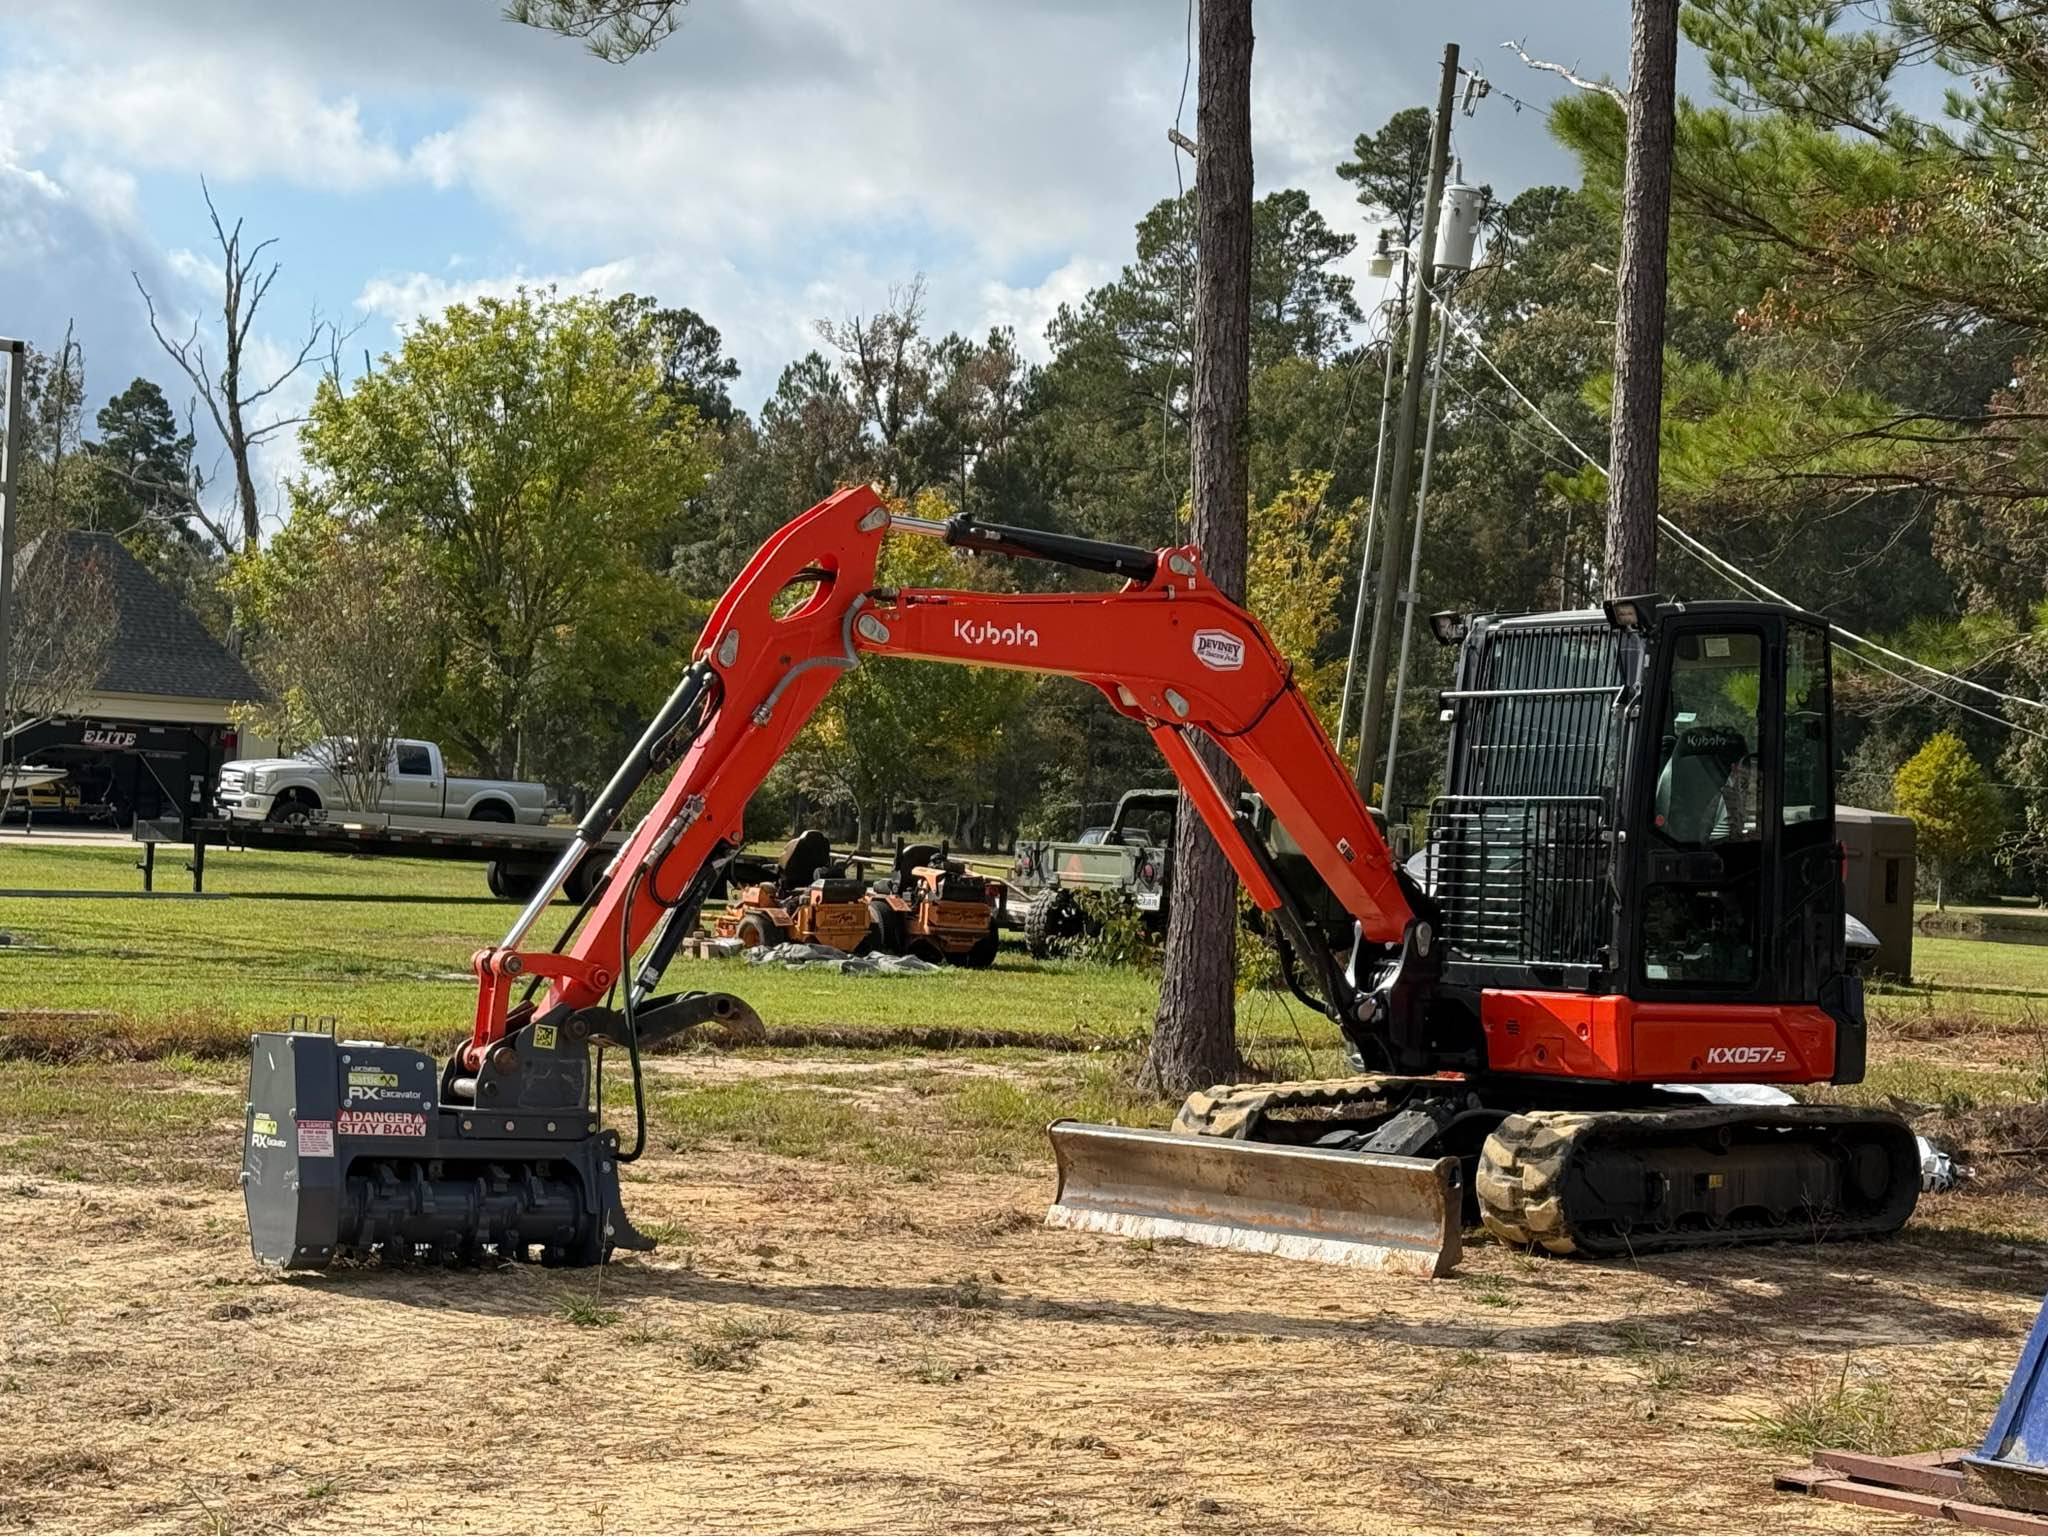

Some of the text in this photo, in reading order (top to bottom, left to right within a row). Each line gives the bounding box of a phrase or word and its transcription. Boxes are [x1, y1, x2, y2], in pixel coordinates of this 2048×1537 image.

[954, 619, 1039, 647] Kubota
[1198, 637, 1241, 657] DEVINEY
[83, 730, 136, 746] ELITE
[1687, 735, 1727, 747] Kubota
[380, 1089, 422, 1100] Excavator
[352, 1111, 413, 1123] DANGER
[339, 1123, 379, 1135] STAY
[382, 1124, 423, 1136] BACK
